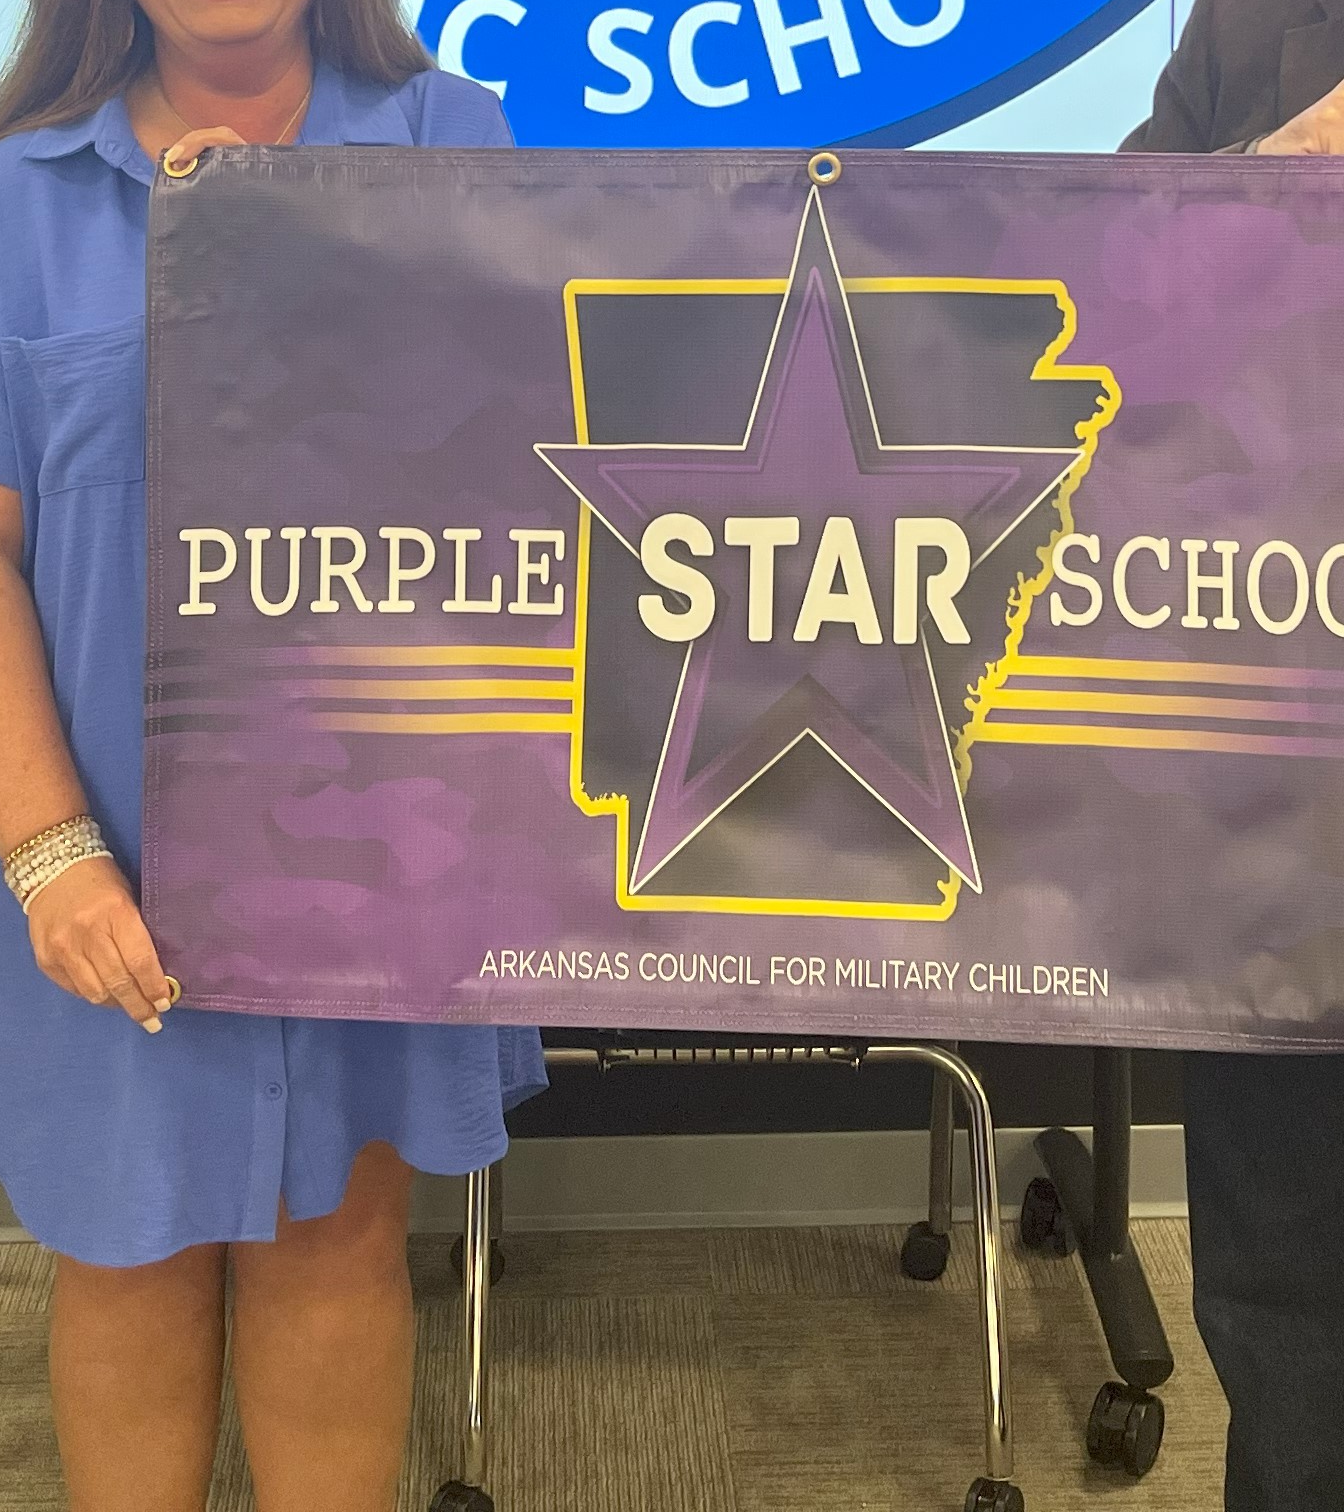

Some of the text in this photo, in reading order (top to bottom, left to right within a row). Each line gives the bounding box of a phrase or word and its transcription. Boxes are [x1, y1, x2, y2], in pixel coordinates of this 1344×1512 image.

[178, 526, 566, 616] PURPLE
[638, 512, 972, 645] STAR
[479, 949, 1109, 997] ARKANSAS COUNCIL FOR MILITARY CHILDREN
